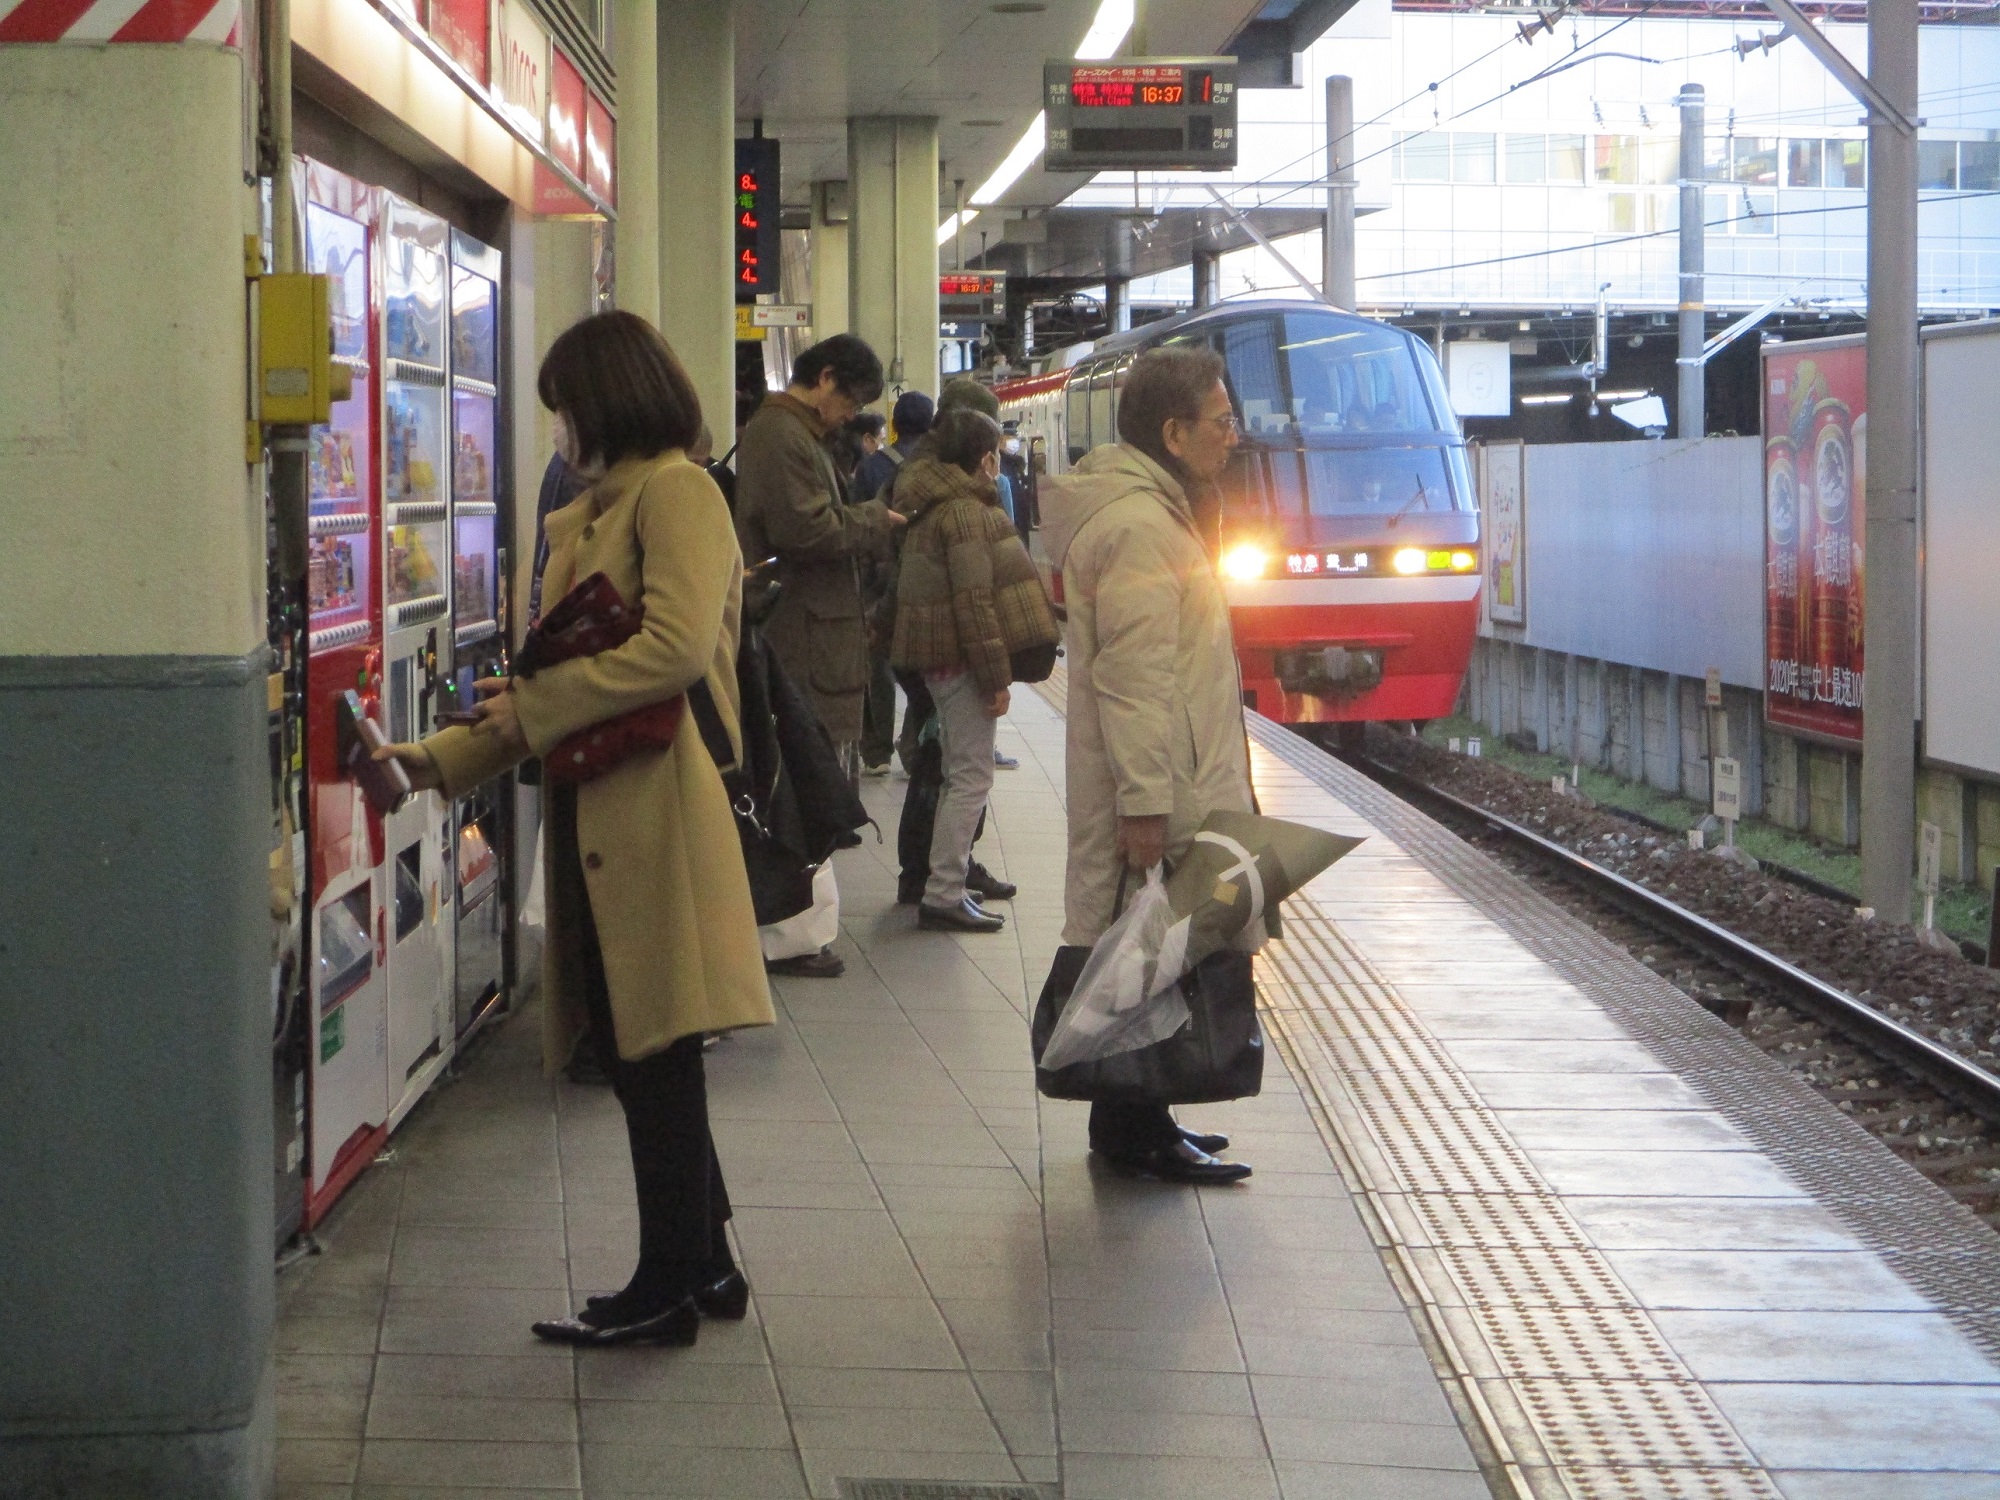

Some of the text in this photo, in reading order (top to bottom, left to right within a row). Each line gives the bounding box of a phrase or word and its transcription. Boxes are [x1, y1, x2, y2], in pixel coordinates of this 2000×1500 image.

[1204, 75, 1211, 102] 1
[1141, 86, 1182, 103] 16:37
[1213, 95, 1229, 104] Car
[1213, 141, 1229, 149] Car
[960, 284, 980, 293] 16:37
